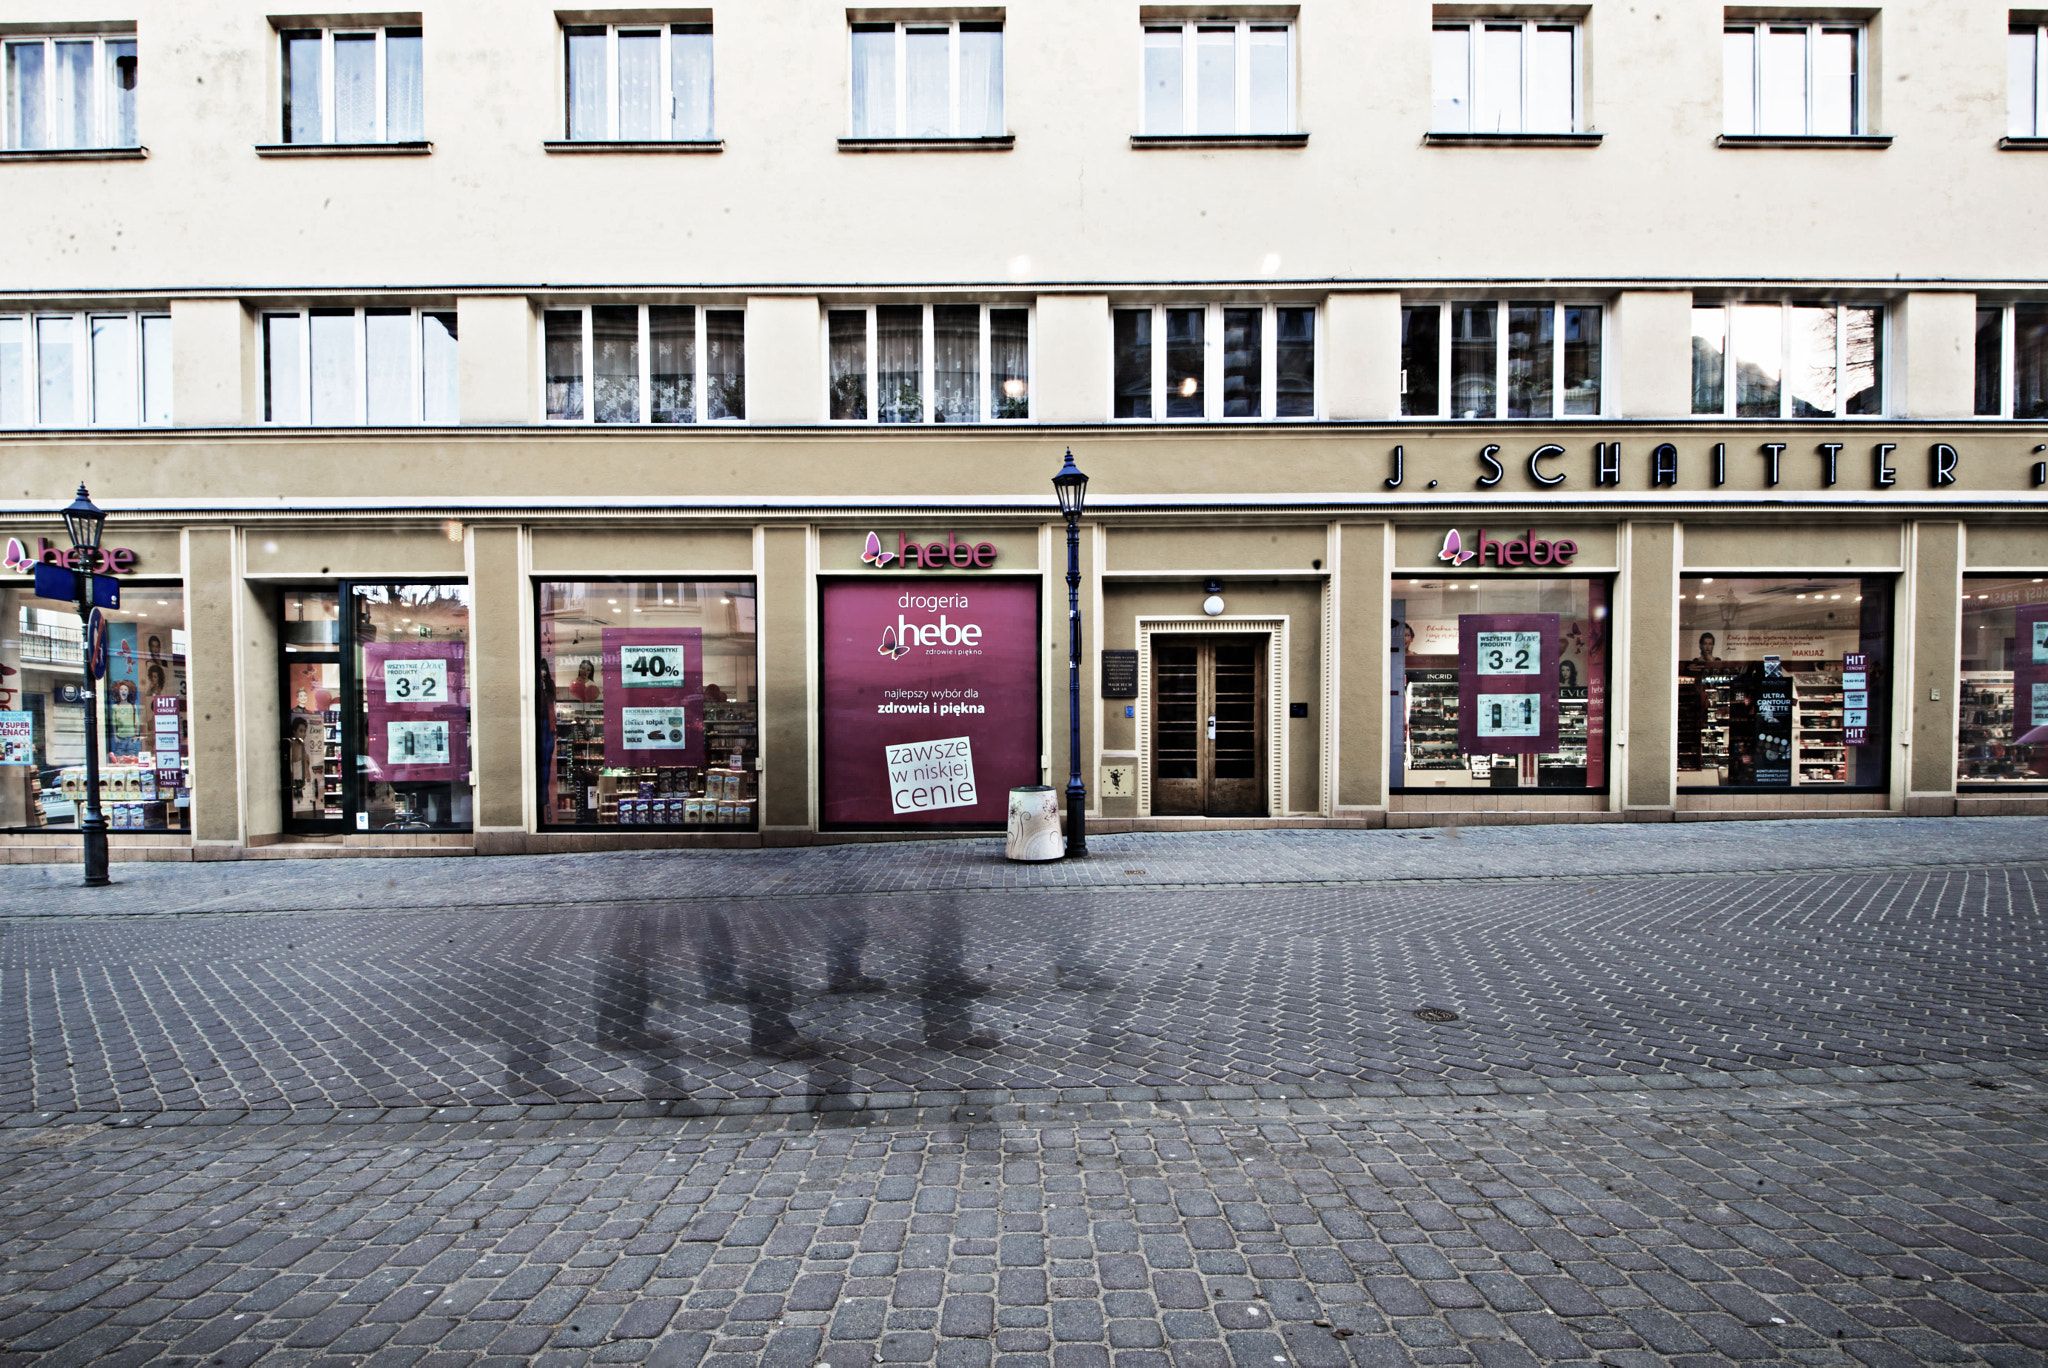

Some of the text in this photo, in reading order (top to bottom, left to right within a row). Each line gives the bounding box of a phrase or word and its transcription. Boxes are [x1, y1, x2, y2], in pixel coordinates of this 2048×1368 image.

[1385, 445, 1437, 488] J.
[1474, 442, 1959, 490] SCHAITTER
[899, 531, 998, 569] hebe
[1478, 528, 1579, 566] hebe
[898, 591, 969, 613] drogeria
[898, 614, 983, 647] hebe
[1489, 649, 1504, 670] 3
[1515, 649, 1530, 670] 2
[1791, 647, 1825, 657] MAKIJAŻ
[1846, 655, 1866, 665] HIT
[626, 655, 680, 677] -40%
[396, 677, 411, 698] 3
[422, 677, 437, 697] 2
[884, 688, 979, 701] najlepszy wybór dla
[156, 697, 176, 708] HIT
[877, 701, 985, 717] zdrowia i piękna
[5, 721, 30, 729] SUPER
[1845, 728, 1865, 739] HIT
[889, 741, 968, 765] zawsze
[159, 770, 179, 780] HIT
[891, 759, 969, 784] w niskiej
[895, 777, 974, 810] cenie
